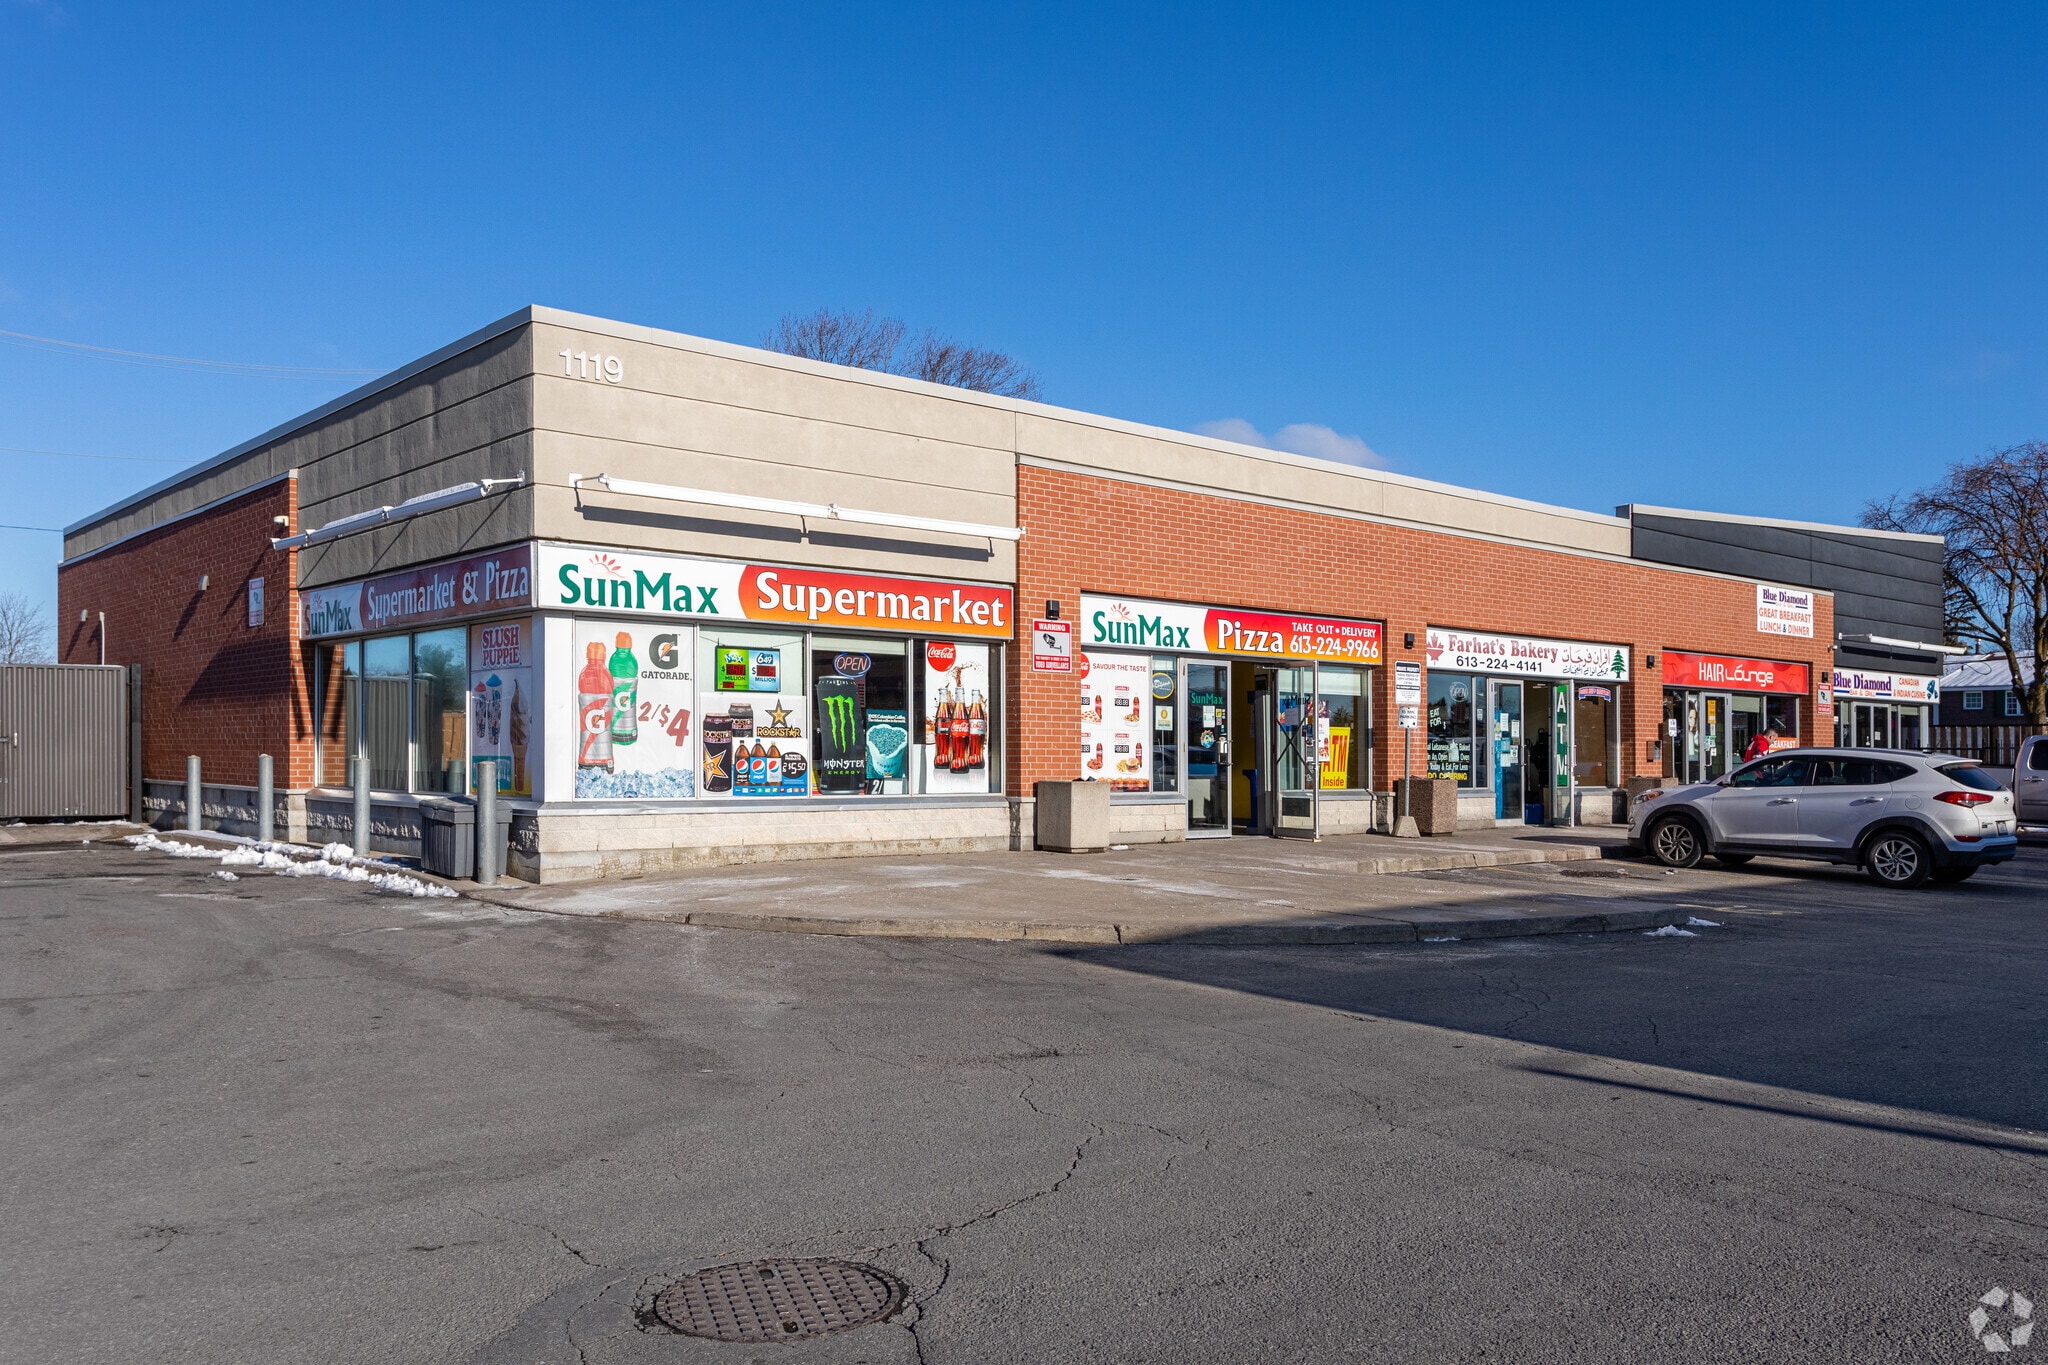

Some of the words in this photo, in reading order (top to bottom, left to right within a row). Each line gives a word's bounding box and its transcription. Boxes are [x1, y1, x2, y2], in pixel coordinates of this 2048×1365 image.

[559, 348, 623, 384] 1119
[368, 573, 456, 625] Supermarket
[462, 570, 479, 604] &
[485, 560, 529, 601] Pizza
[559, 564, 719, 614] SunMax
[756, 571, 1006, 628] Supermarket
[1763, 589, 1777, 601] Blue
[1779, 591, 1808, 605] Diamond
[305, 599, 352, 635] SunMax
[1759, 607, 1778, 618] GREAT
[1779, 610, 1811, 623] BREAKFAST
[1039, 623, 1066, 632] WARNING
[1093, 610, 1190, 648] SunMax
[1217, 618, 1284, 653] Pizza
[1292, 622, 1313, 633] TAKE
[1316, 624, 1334, 635] OUT
[1341, 626, 1377, 638] DELIVERY
[1760, 621, 1781, 632] LUNCH
[1788, 624, 1809, 636] DINNER
[482, 626, 520, 649] SLUSH
[1290, 634, 1378, 659] 613-224-9966
[1448, 634, 1505, 656] Farhat's
[1511, 640, 1558, 663] Bakery
[836, 656, 868, 671] OPEN
[1456, 655, 1542, 673] 613-224-4141
[1699, 662, 1724, 682] HAIR
[641, 671, 690, 680] GATORADE
[1834, 672, 1852, 689] Blue
[1853, 673, 1892, 691] Diamond
[1191, 692, 1223, 705] SunMax
[1769, 740, 1796, 749] EAKFAST
[1322, 776, 1344, 787] Inside
